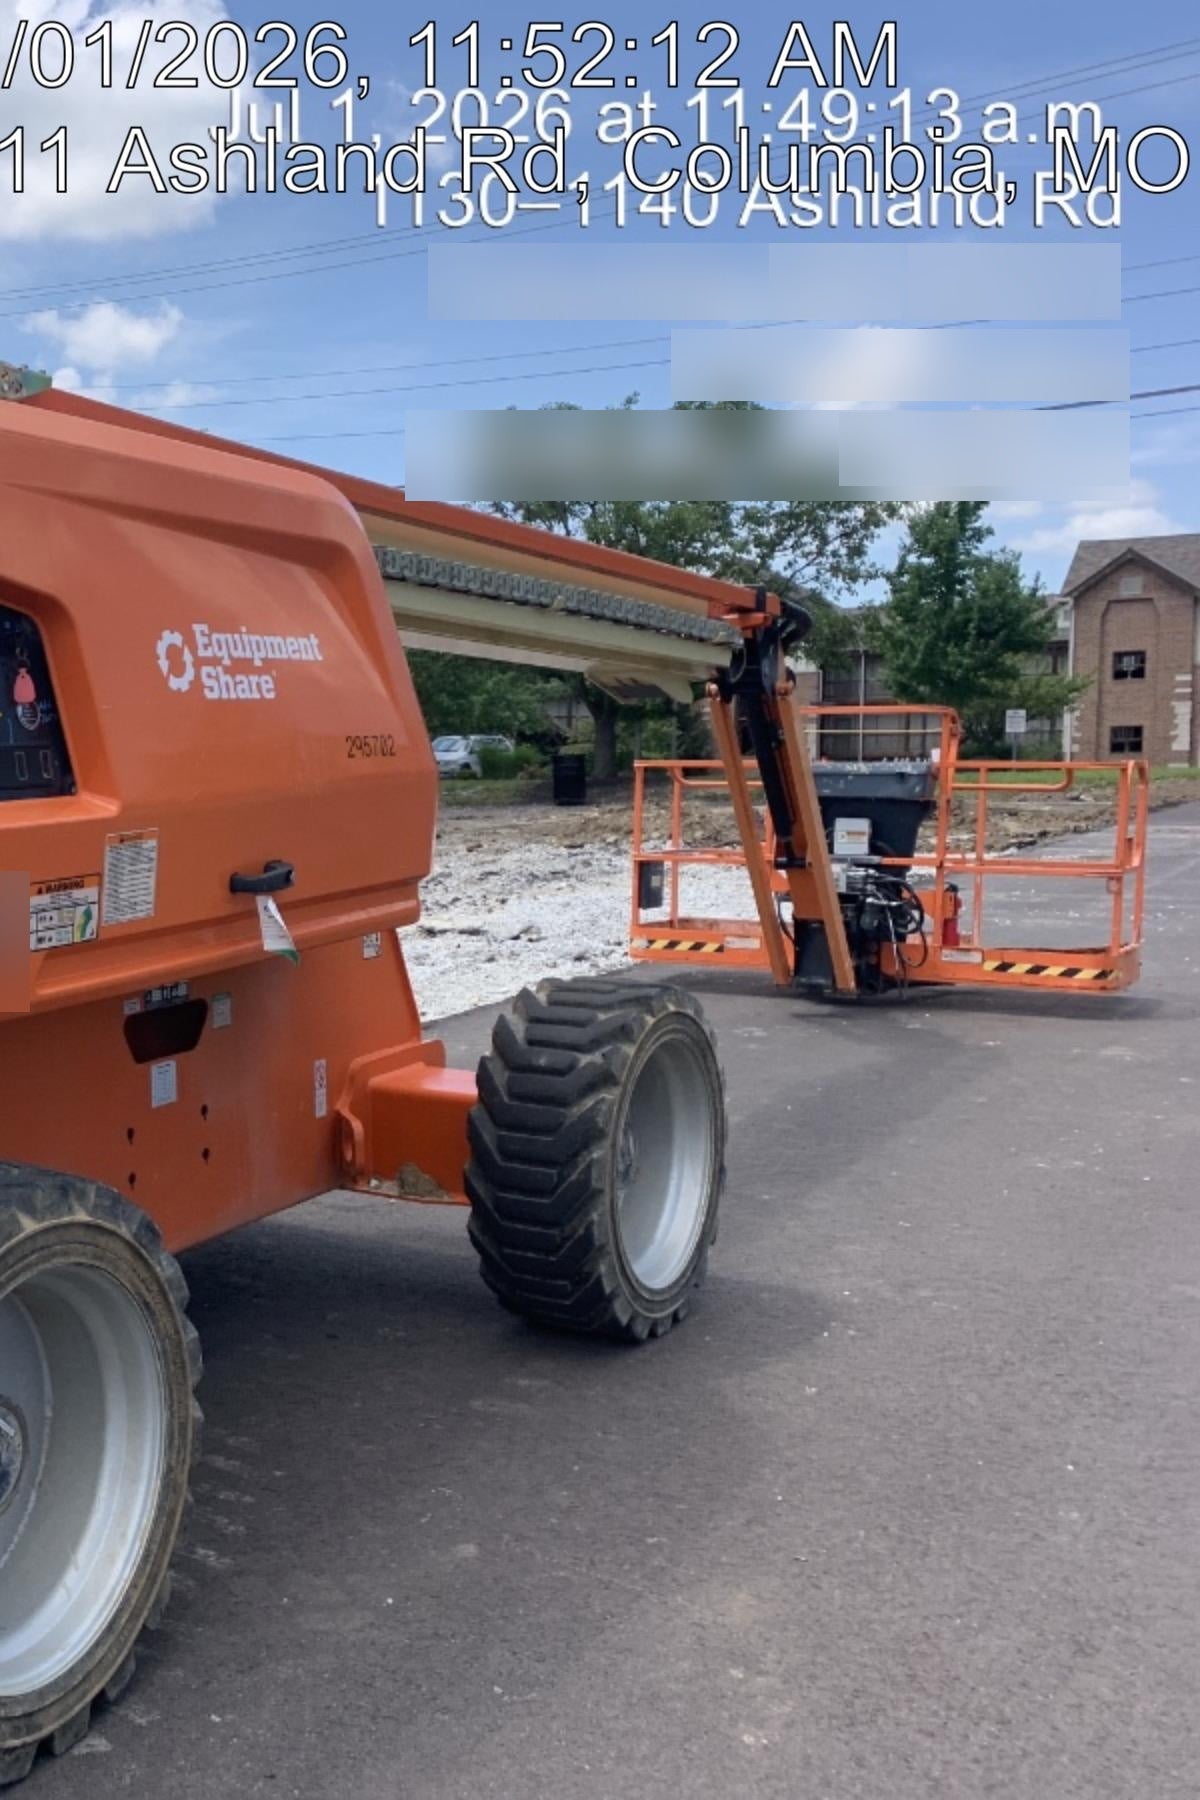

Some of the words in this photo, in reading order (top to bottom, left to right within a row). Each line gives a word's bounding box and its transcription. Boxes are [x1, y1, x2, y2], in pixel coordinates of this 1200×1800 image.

[192, 623, 324, 667] Equipment
[200, 666, 276, 700] Share
[345, 734, 397, 759] 295702
